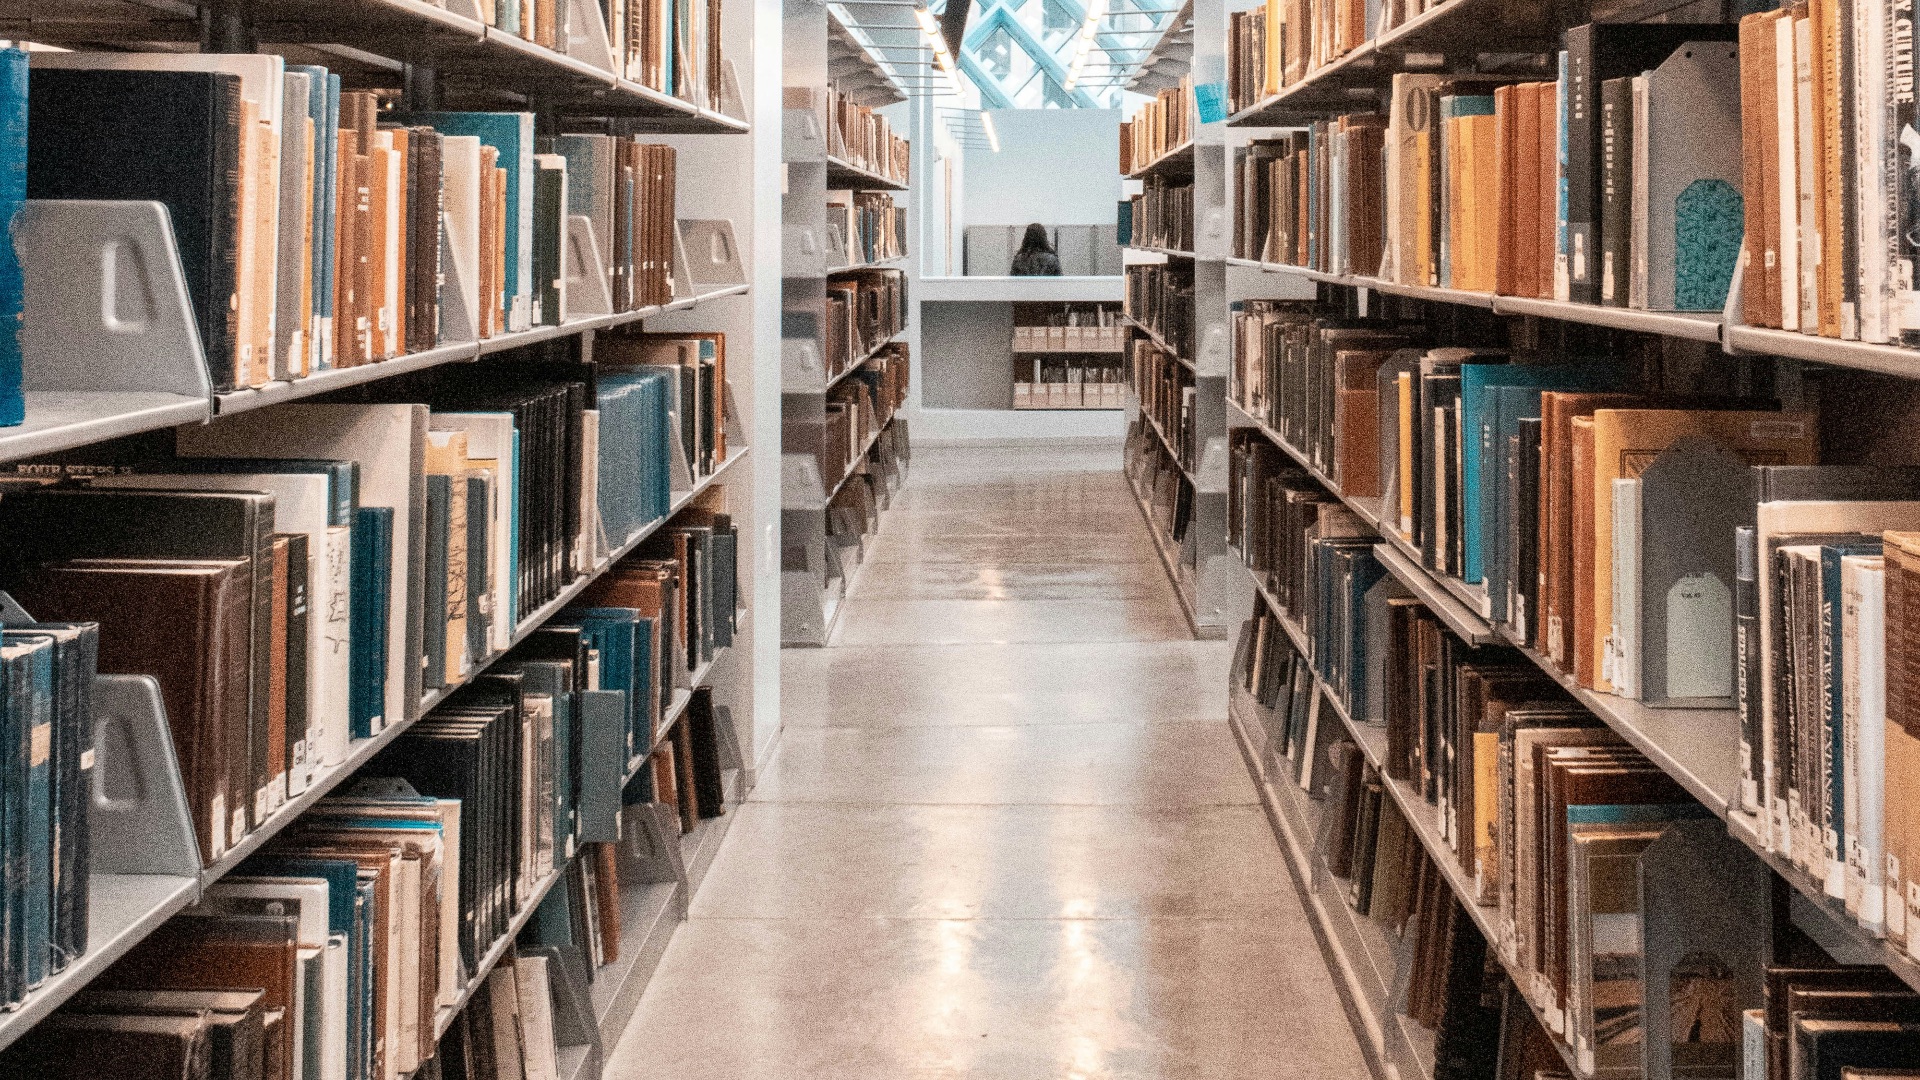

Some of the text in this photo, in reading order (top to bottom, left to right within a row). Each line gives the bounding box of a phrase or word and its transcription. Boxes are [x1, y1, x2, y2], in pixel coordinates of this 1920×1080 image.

[1826, 26, 1835, 97] SOLDIER
[1895, 18, 1914, 105] CULTURE
[1826, 105, 1834, 140] AND
[1886, 147, 1898, 230] AMERICAN
[1737, 624, 1747, 698] SEDUCED
[1823, 601, 1834, 720] WESTWARD
[1824, 725, 1833, 829] EXPANSIO
